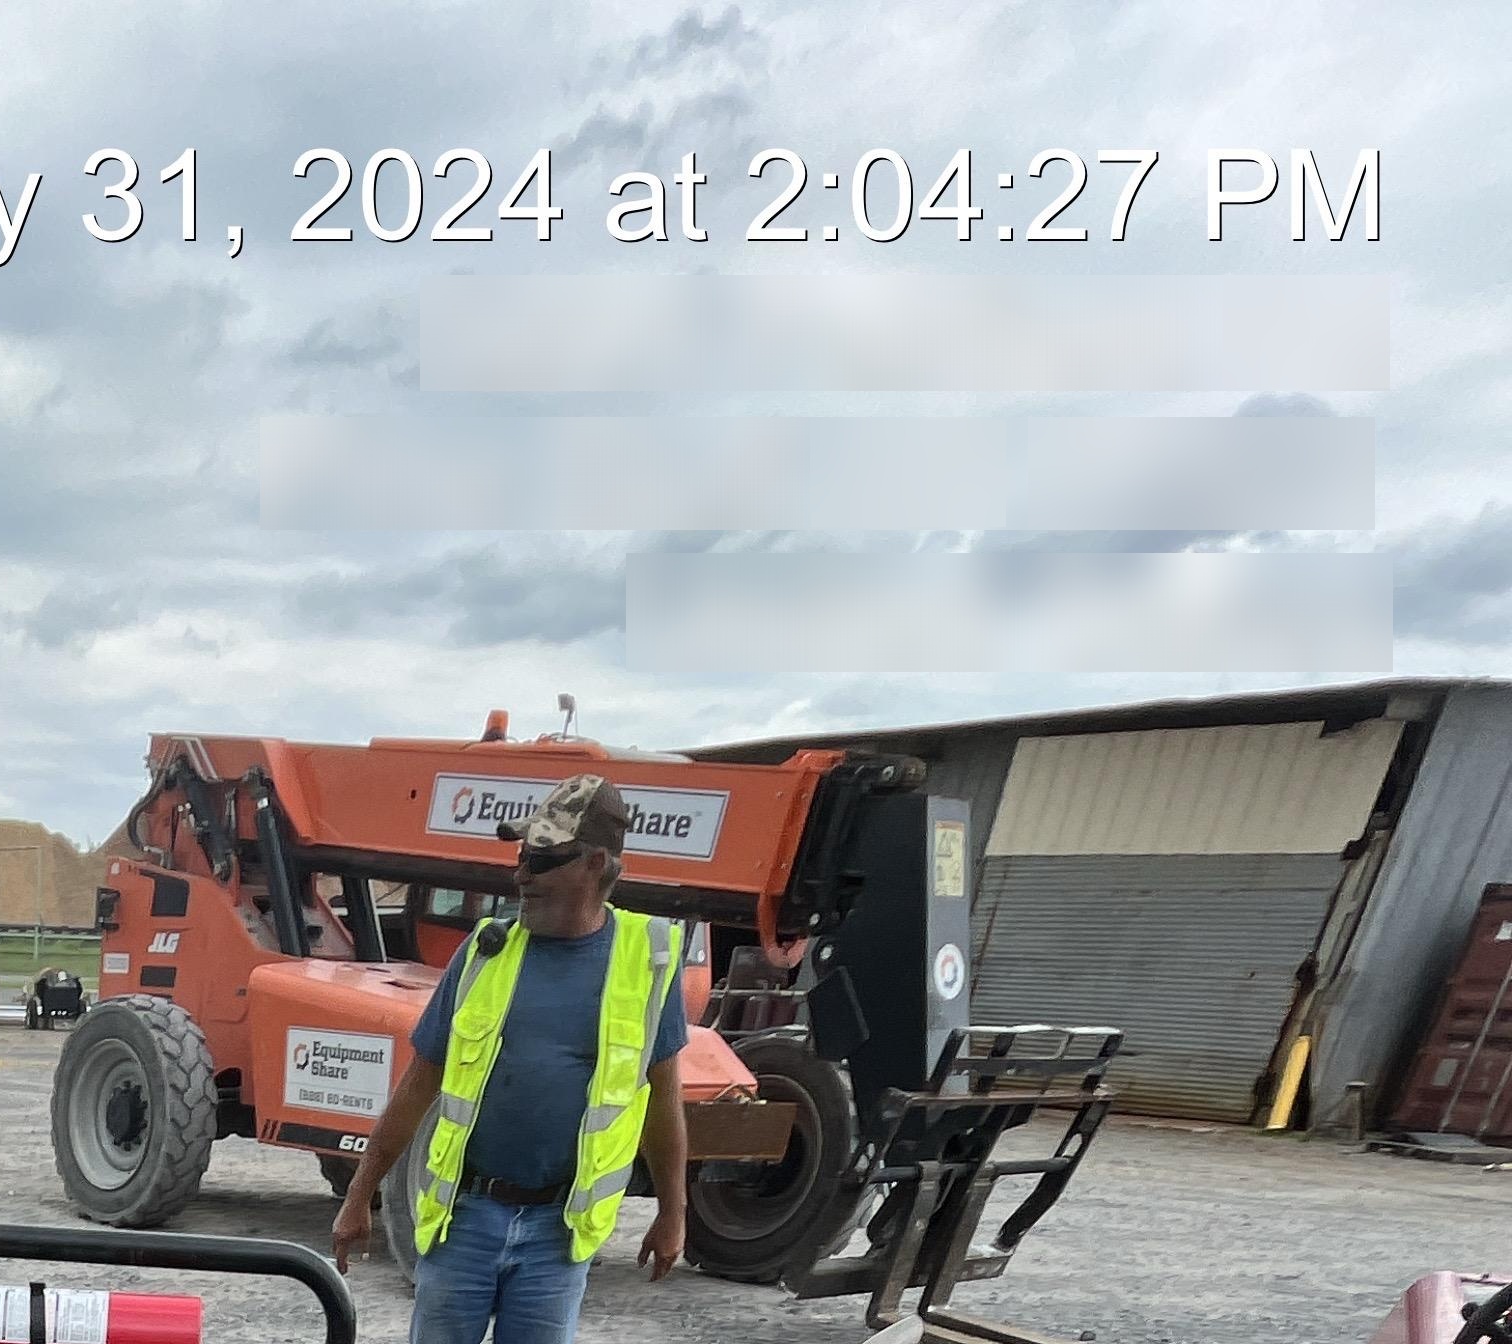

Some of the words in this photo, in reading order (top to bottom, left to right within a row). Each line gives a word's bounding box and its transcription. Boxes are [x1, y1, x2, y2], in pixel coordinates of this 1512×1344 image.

[147, 932, 181, 953] JLG
[312, 1040, 385, 1064] Equipment
[311, 1061, 349, 1080] Share
